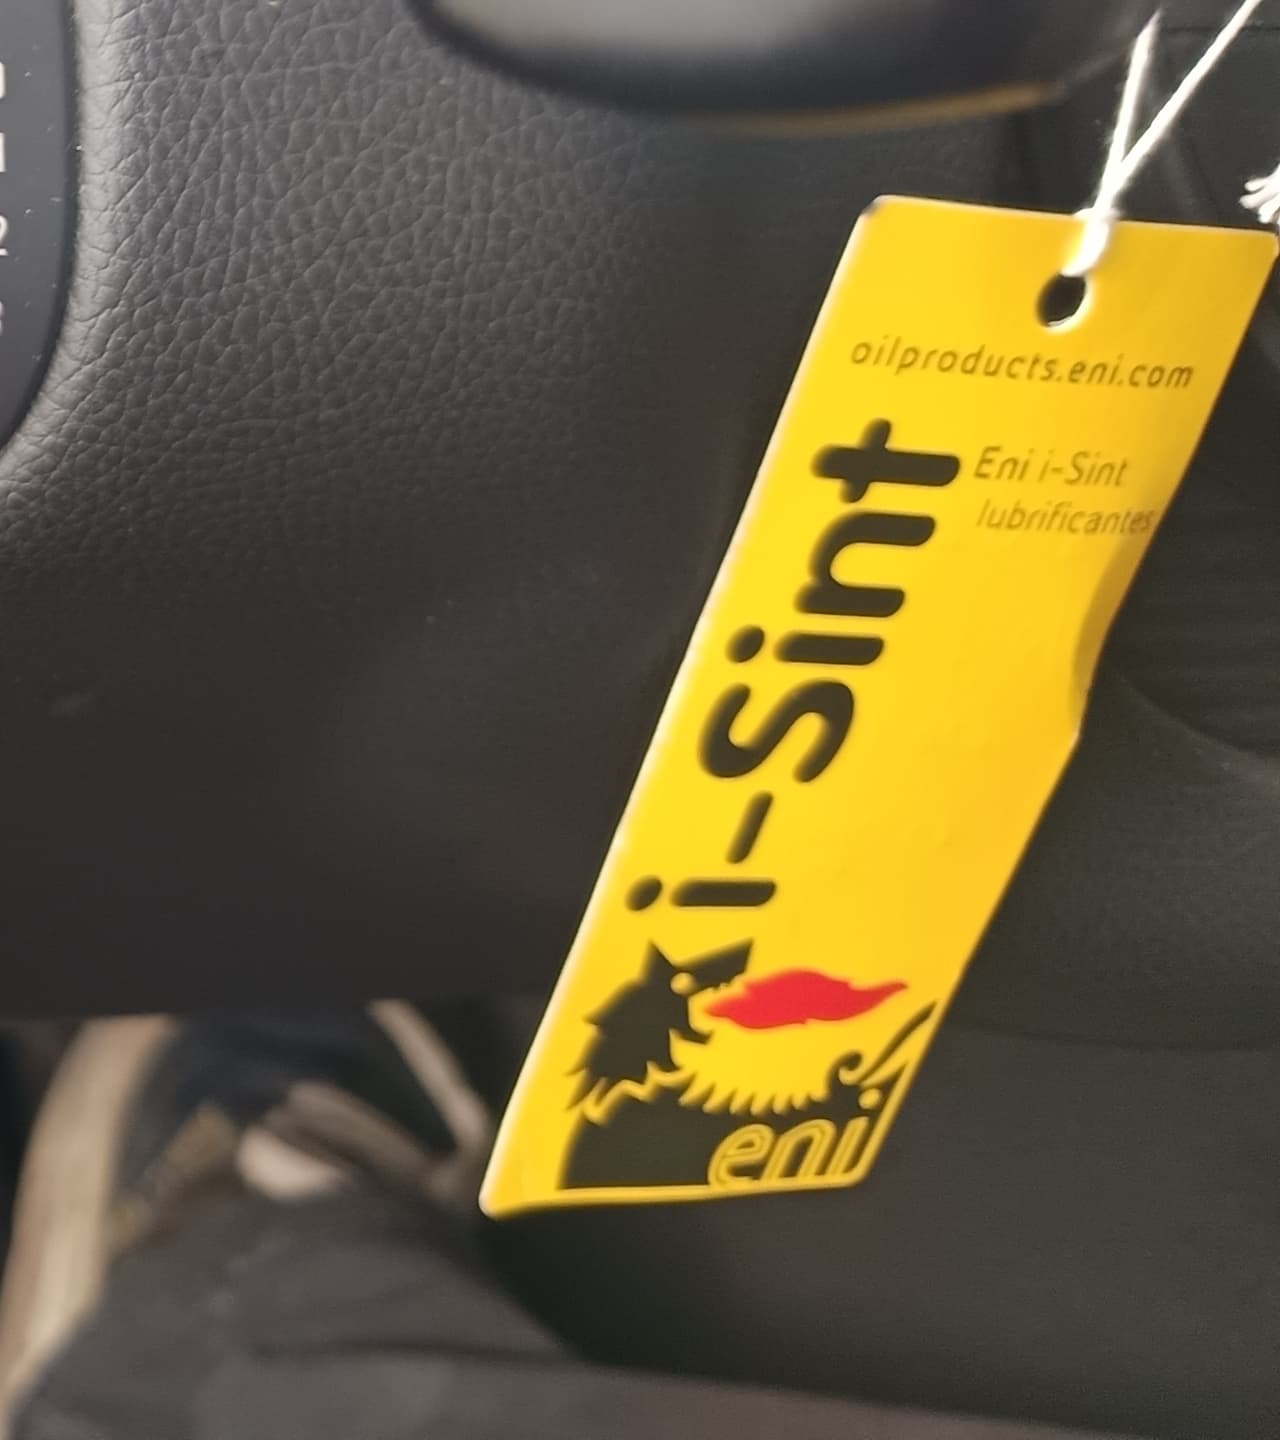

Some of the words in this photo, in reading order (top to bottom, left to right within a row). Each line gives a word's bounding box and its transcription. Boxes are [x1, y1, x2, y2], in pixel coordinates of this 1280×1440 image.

[850, 334, 1195, 389] oilproducts.eni.com
[973, 445, 1032, 482] Eni
[1040, 448, 1129, 488] i-Sint
[976, 498, 1156, 536] lubrificantes
[625, 417, 961, 909] i-Sint
[707, 1088, 883, 1187] eni
